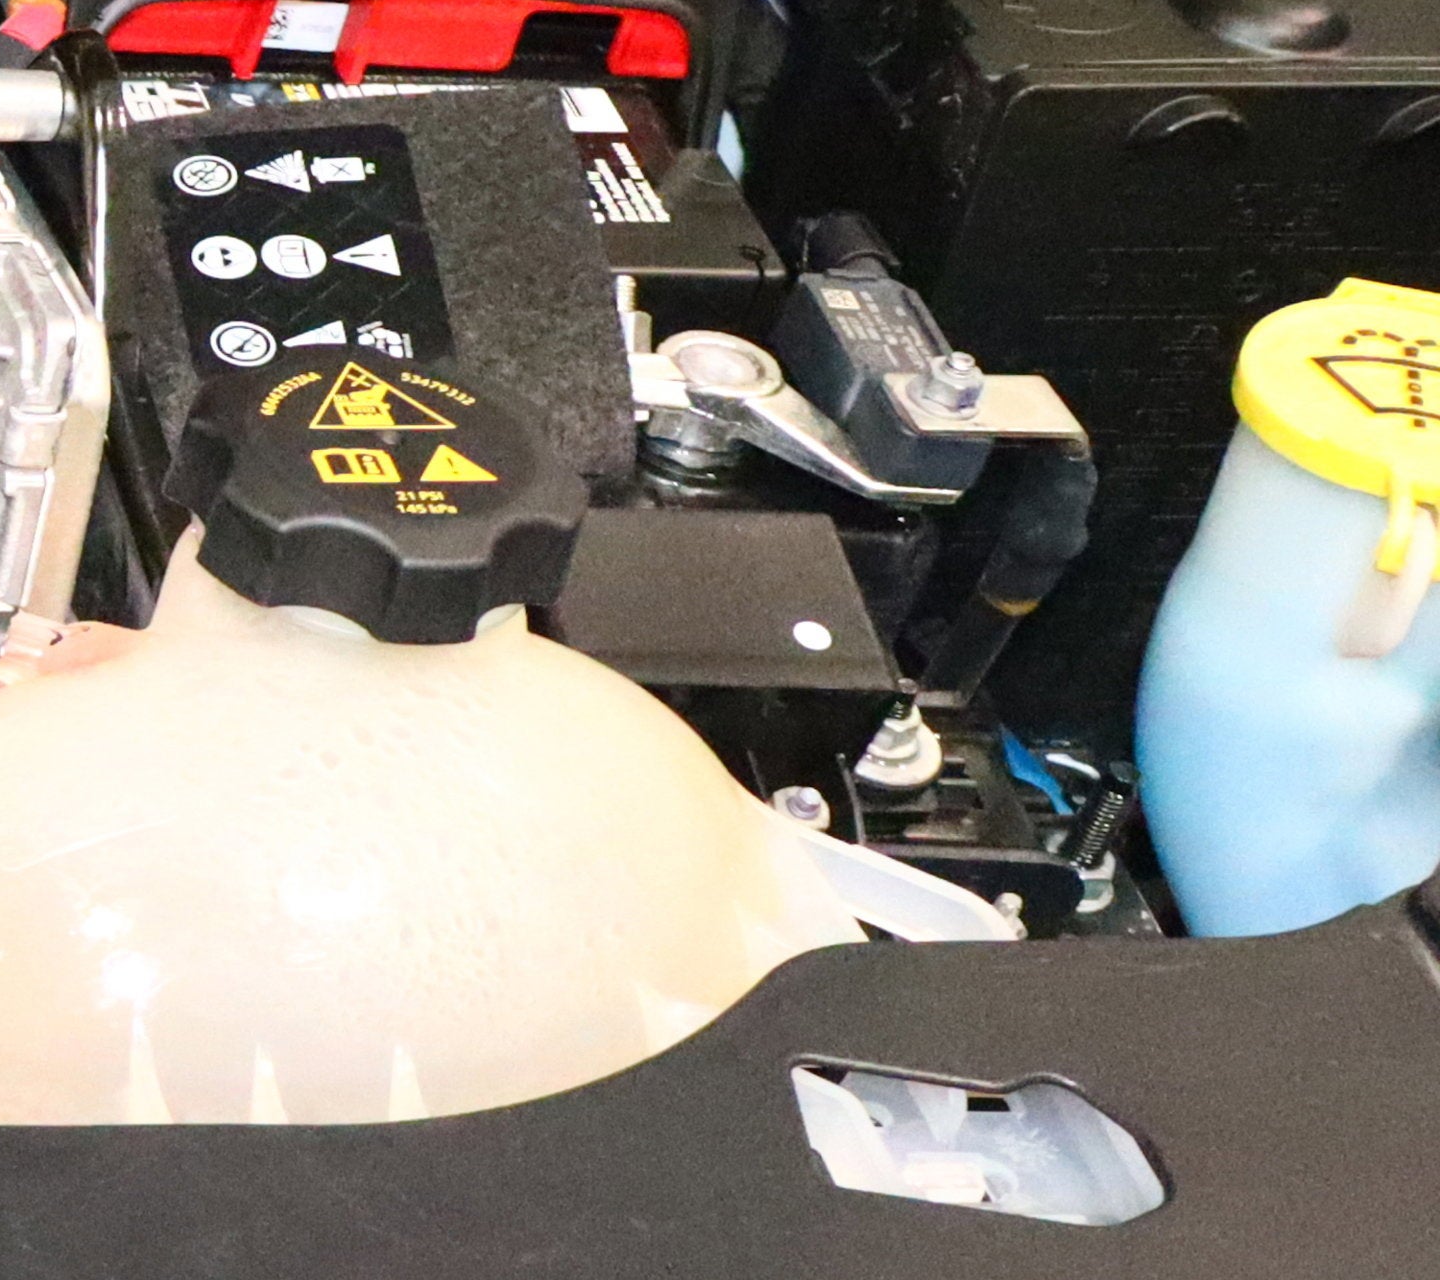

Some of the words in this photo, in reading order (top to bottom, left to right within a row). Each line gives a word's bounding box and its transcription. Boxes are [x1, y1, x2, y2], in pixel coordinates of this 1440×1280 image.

[395, 491, 416, 502] 21
[418, 491, 445, 501] PSI
[395, 504, 427, 514] 145
[428, 503, 458, 514] kPa
